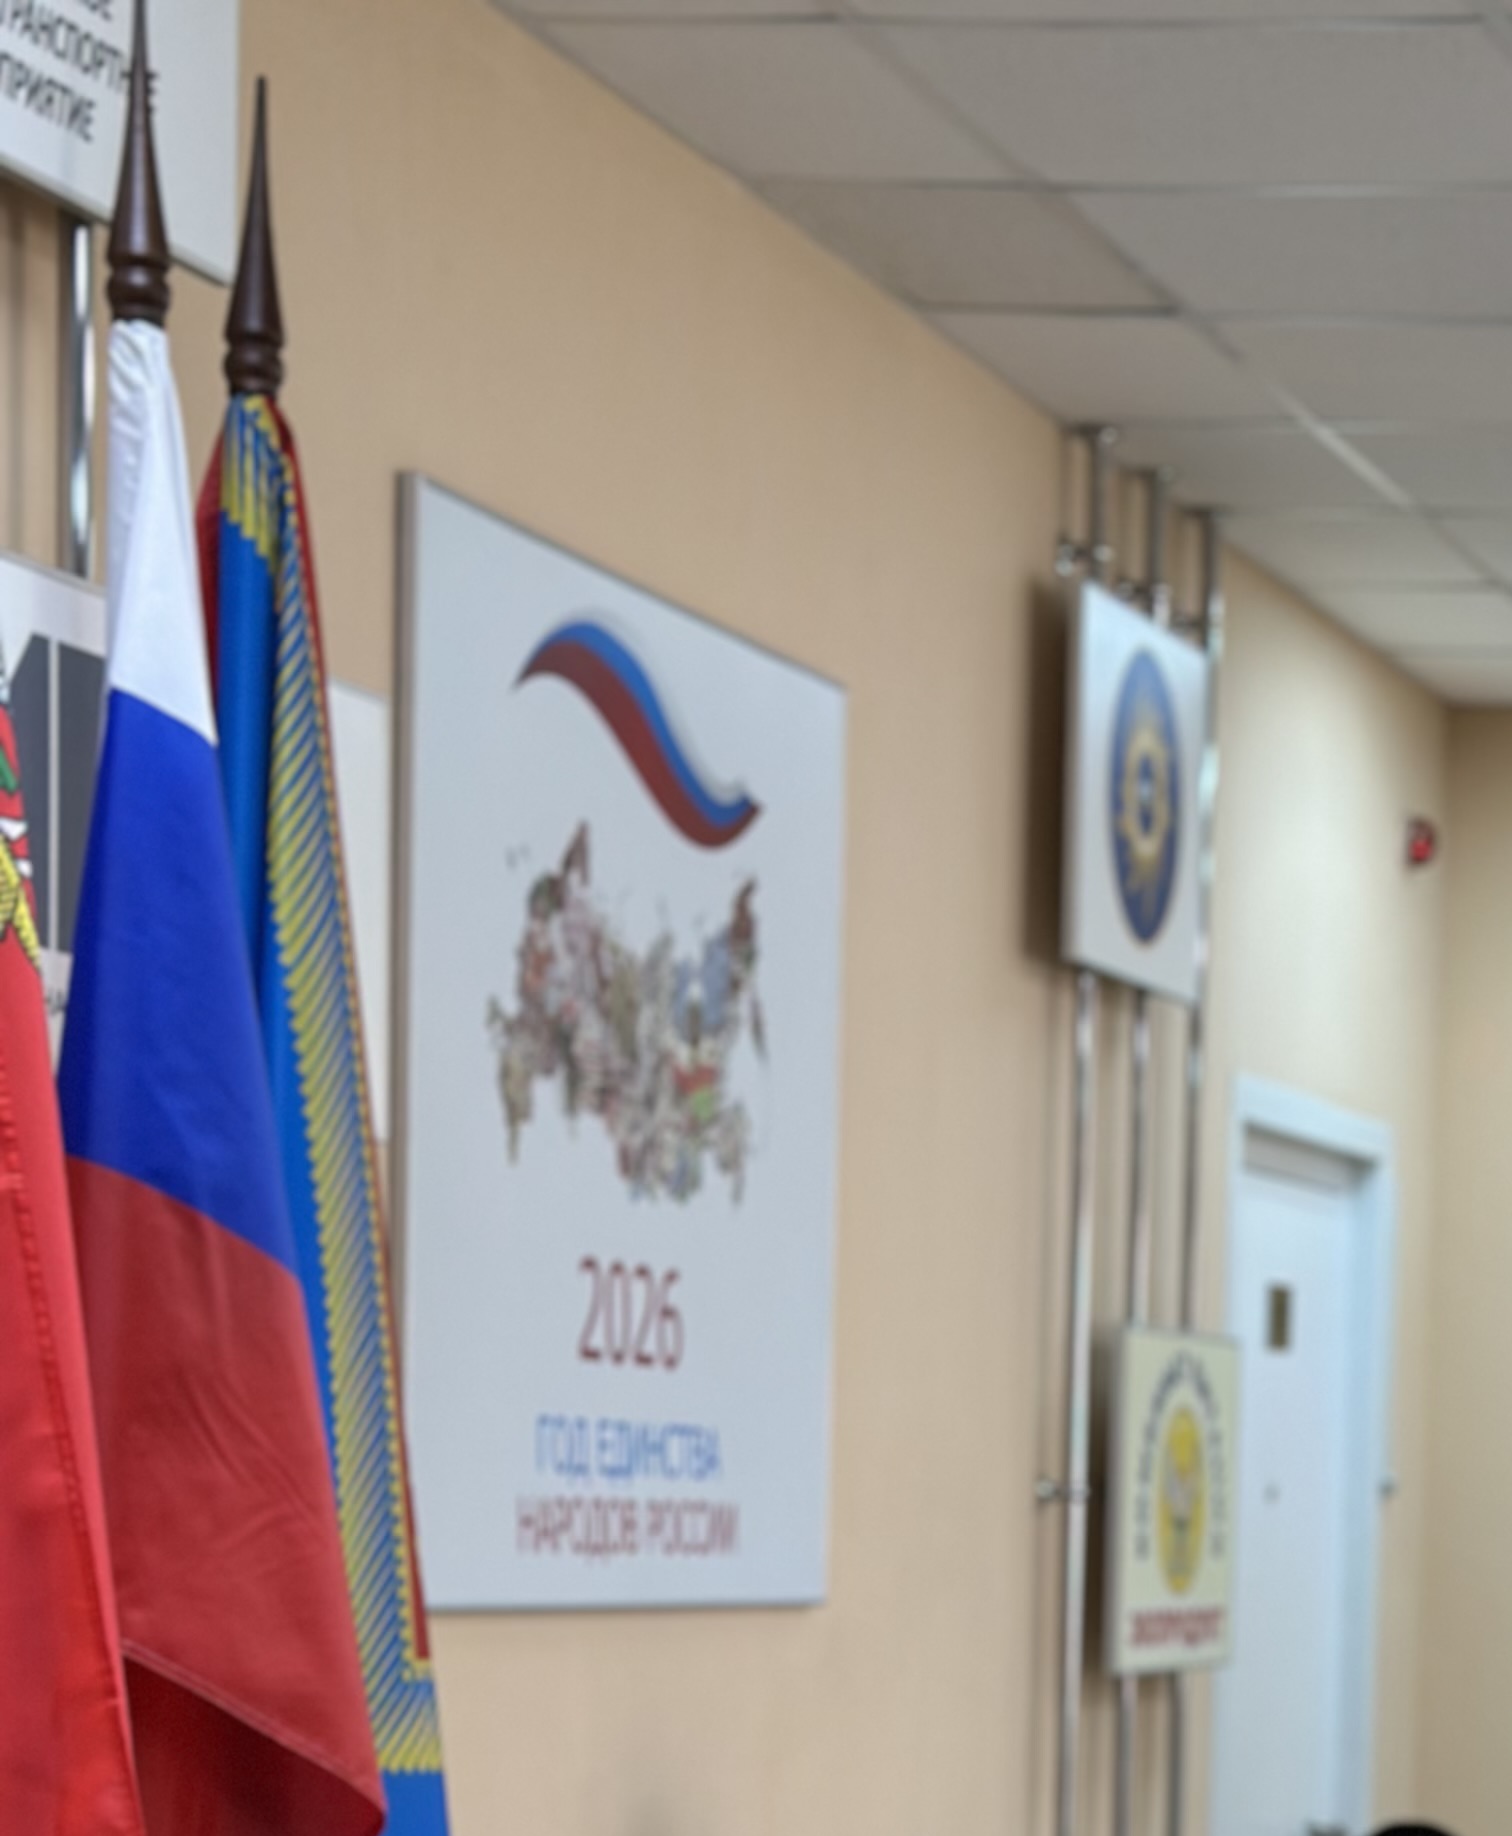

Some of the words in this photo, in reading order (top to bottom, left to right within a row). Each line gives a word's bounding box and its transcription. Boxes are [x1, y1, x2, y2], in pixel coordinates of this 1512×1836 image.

[575, 1254, 686, 1373] 2026
[534, 1411, 592, 1488] ГОД
[595, 1415, 724, 1488] ЕДИНСТВА
[514, 1494, 639, 1566] НАРОДОВ
[646, 1495, 742, 1558] РОССИИ
